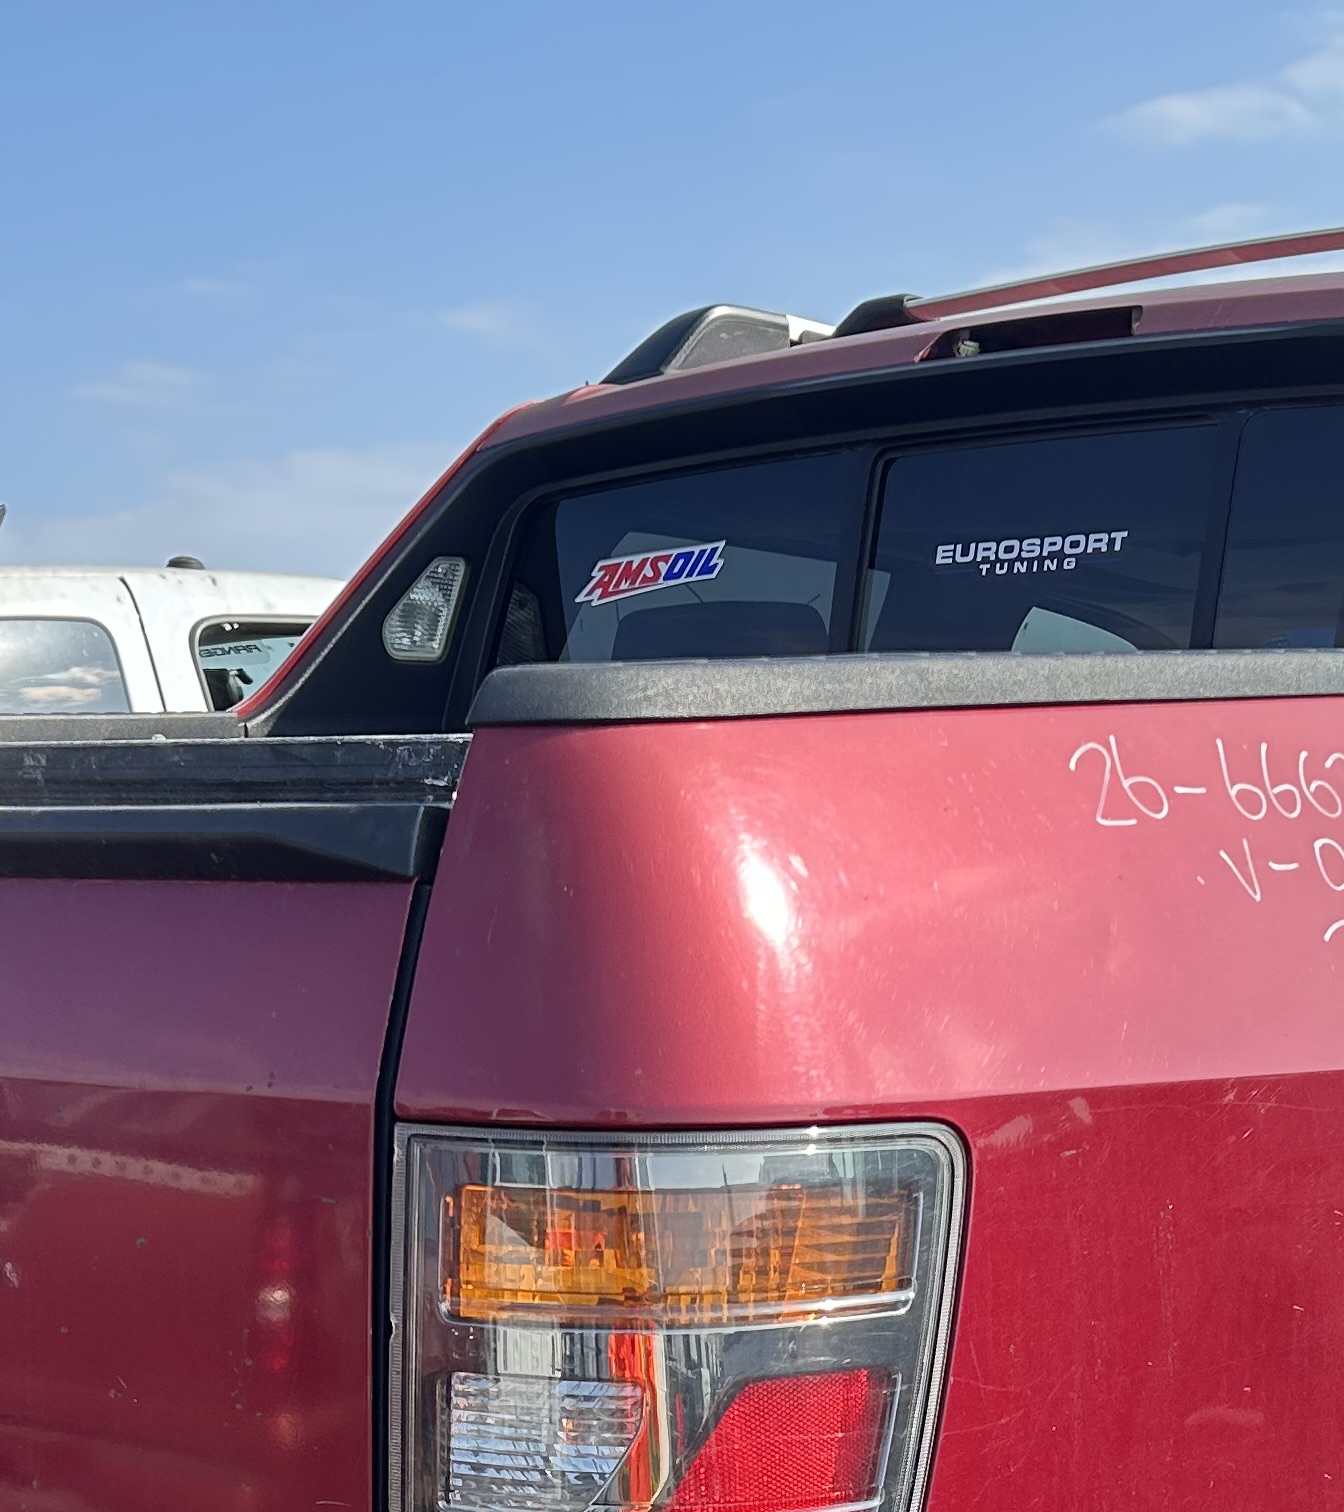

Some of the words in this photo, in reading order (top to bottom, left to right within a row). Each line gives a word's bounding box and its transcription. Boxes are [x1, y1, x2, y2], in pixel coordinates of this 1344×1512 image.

[935, 530, 1129, 565] EUROSPORT
[582, 546, 722, 602] AMSOIL
[978, 557, 1077, 576] TUNING
